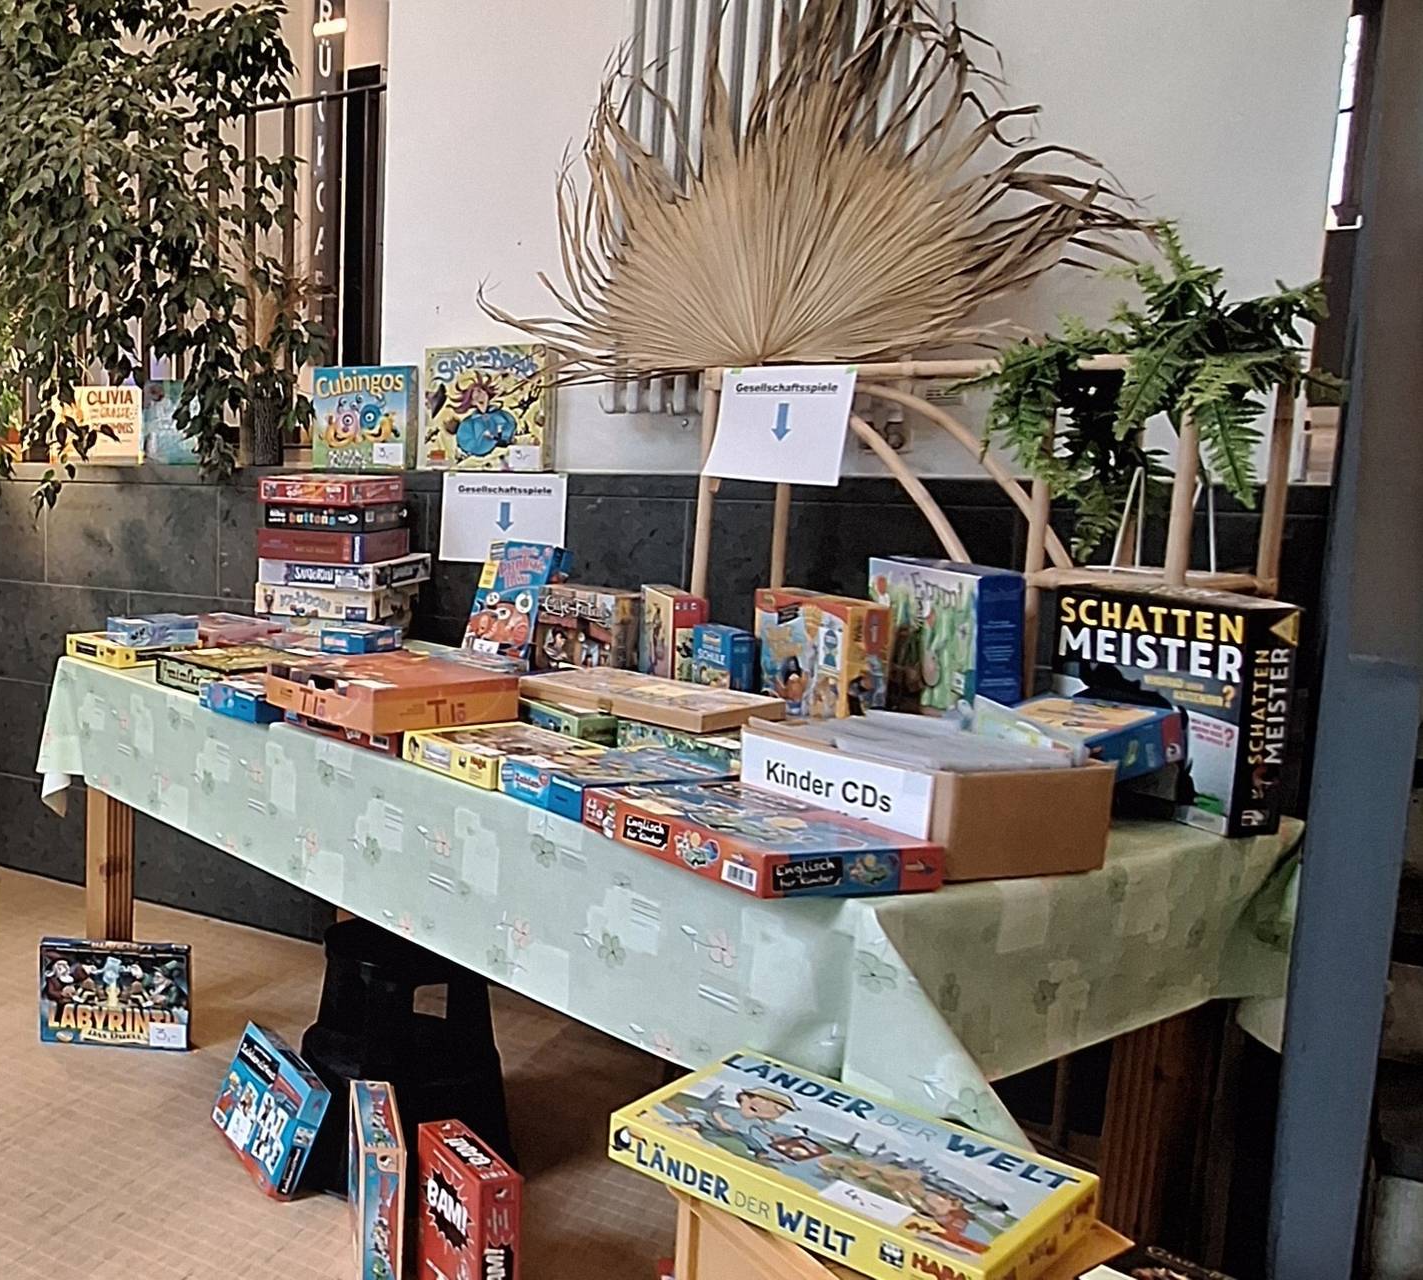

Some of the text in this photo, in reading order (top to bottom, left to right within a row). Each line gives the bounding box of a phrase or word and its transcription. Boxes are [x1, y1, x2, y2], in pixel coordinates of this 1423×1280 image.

[315, 368, 405, 399] Cubingos
[735, 382, 839, 394] Gesellschaftsspiele
[458, 484, 553, 497] Gesellschaftsspiele
[1060, 596, 1245, 645] SCHATTEN
[1058, 625, 1243, 684] MEISTER
[1248, 649, 1270, 764] SCHATTEN
[1264, 648, 1291, 765] MEISTER
[766, 760, 892, 813] Kinder CDs
[626, 816, 665, 835] Englisch
[776, 857, 836, 879] Englisch
[48, 1003, 181, 1034] LABYRINTH
[721, 1053, 1081, 1189] LÄNDER DER WELT
[427, 1177, 468, 1238] BAM!
[634, 1141, 857, 1258] LÄNDER DER WELT
